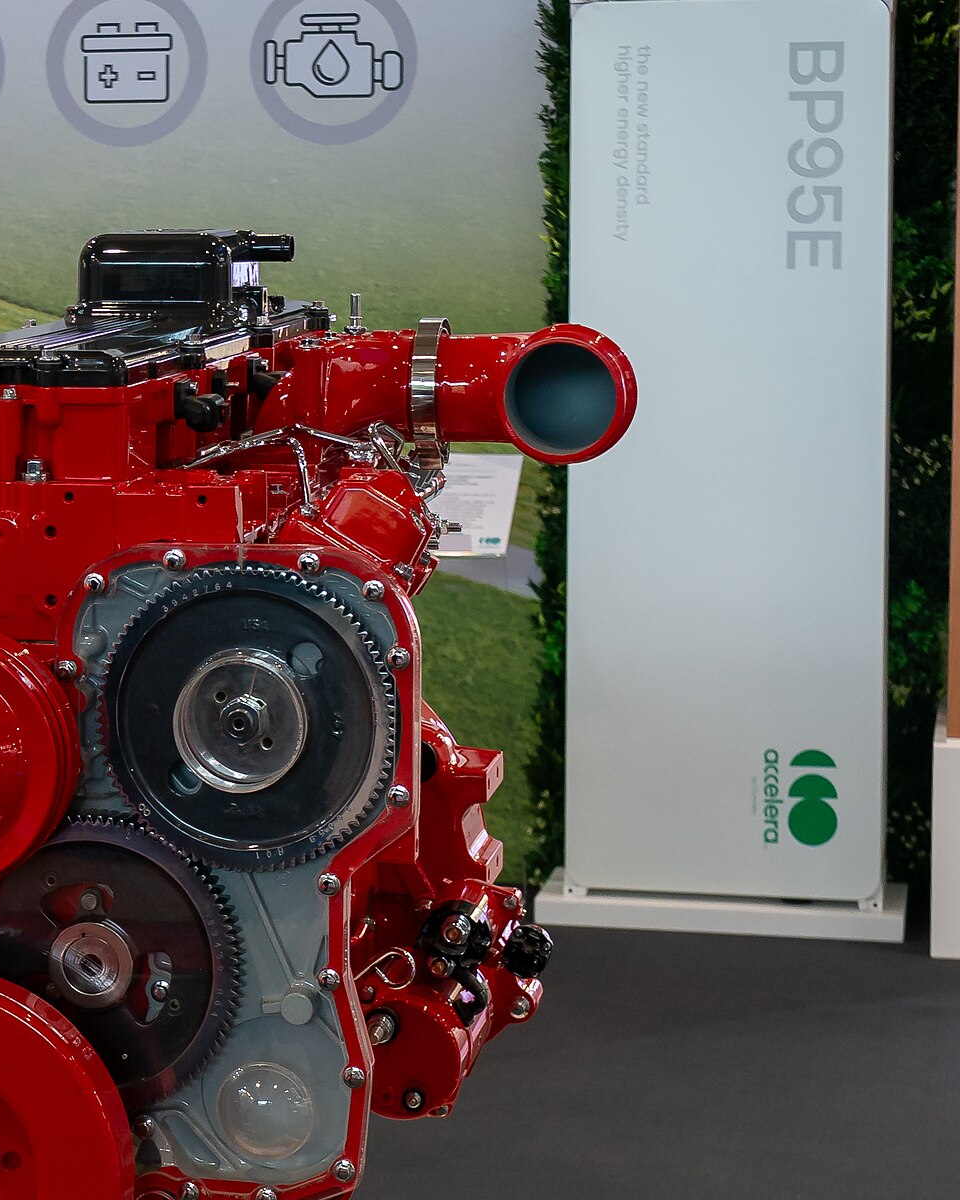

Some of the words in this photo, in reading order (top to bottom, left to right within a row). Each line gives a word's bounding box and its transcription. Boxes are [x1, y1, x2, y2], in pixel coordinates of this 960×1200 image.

[613, 45, 632, 103] higher
[636, 44, 651, 76] the
[636, 80, 649, 119] new
[612, 107, 629, 170] energy
[636, 122, 651, 206] standard
[786, 41, 845, 271] BP95E
[612, 175, 631, 242] density
[763, 748, 784, 844] accelera
